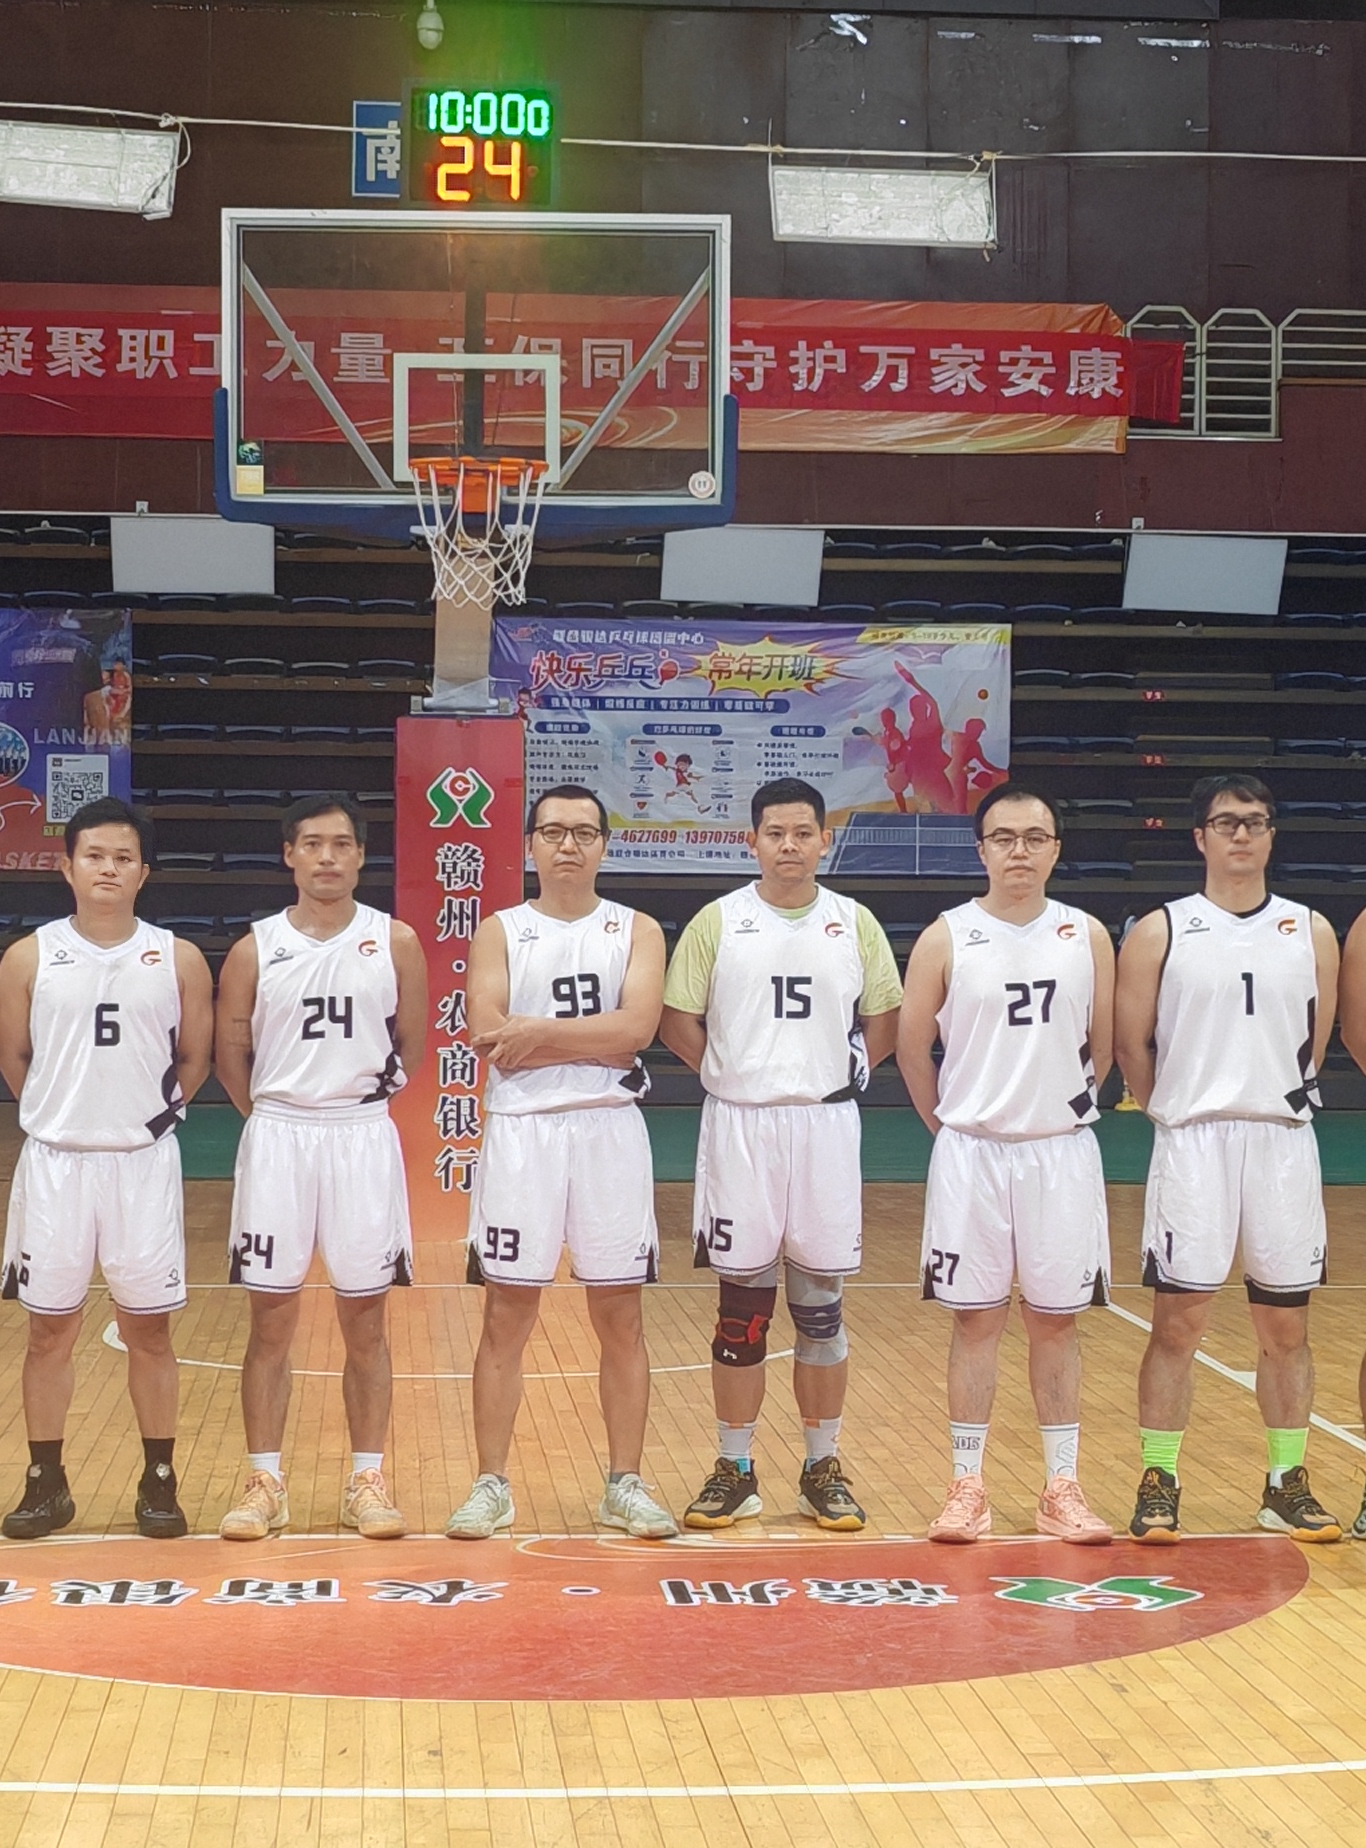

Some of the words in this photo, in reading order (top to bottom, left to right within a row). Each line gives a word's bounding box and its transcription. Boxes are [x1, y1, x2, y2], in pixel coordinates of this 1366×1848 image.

[436, 136, 523, 201] 24
[532, 650, 658, 691] 快乐乒乓
[708, 652, 817, 682] 常年开班
[33, 728, 131, 745] LANJIAN
[552, 973, 602, 1018] 93
[771, 976, 813, 1019] 15
[1004, 979, 1057, 1026] 27
[1240, 972, 1255, 1016] 1
[94, 1003, 121, 1047] 6
[300, 996, 354, 1040] 24
[240, 1231, 275, 1270] 24
[483, 1226, 521, 1262] 93
[708, 1216, 734, 1252] 15
[1164, 1230, 1174, 1265] 1
[931, 1248, 961, 1287] 27
